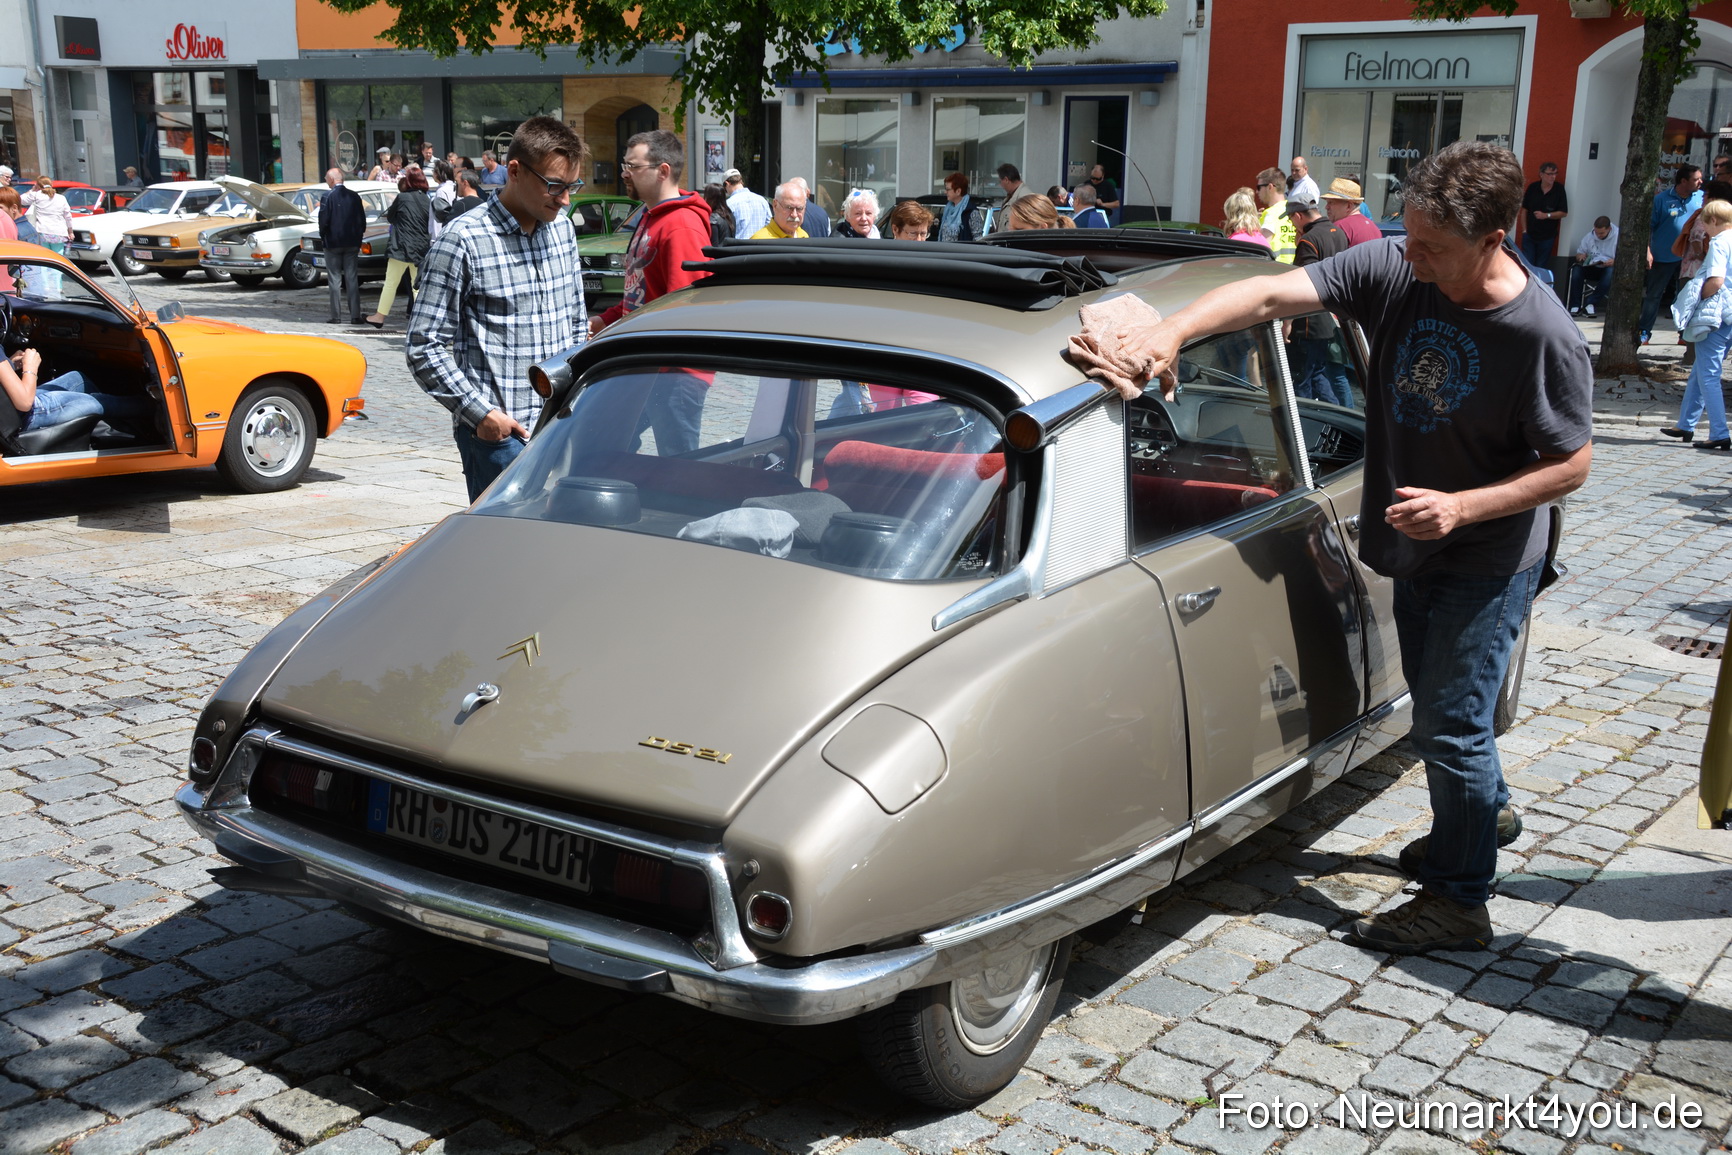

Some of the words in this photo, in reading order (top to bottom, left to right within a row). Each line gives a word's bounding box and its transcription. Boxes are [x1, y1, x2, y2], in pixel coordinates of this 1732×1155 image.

[166, 23, 226, 60] s.Oliver
[1345, 51, 1470, 80] fielmann
[1456, 331, 1480, 382] VINTAGE
[1422, 387, 1443, 406] TAILOR
[638, 736, 694, 755] DS
[694, 748, 732, 764] 21
[388, 786, 429, 838] RH
[448, 802, 491, 855] DS
[499, 817, 592, 884] 210H
